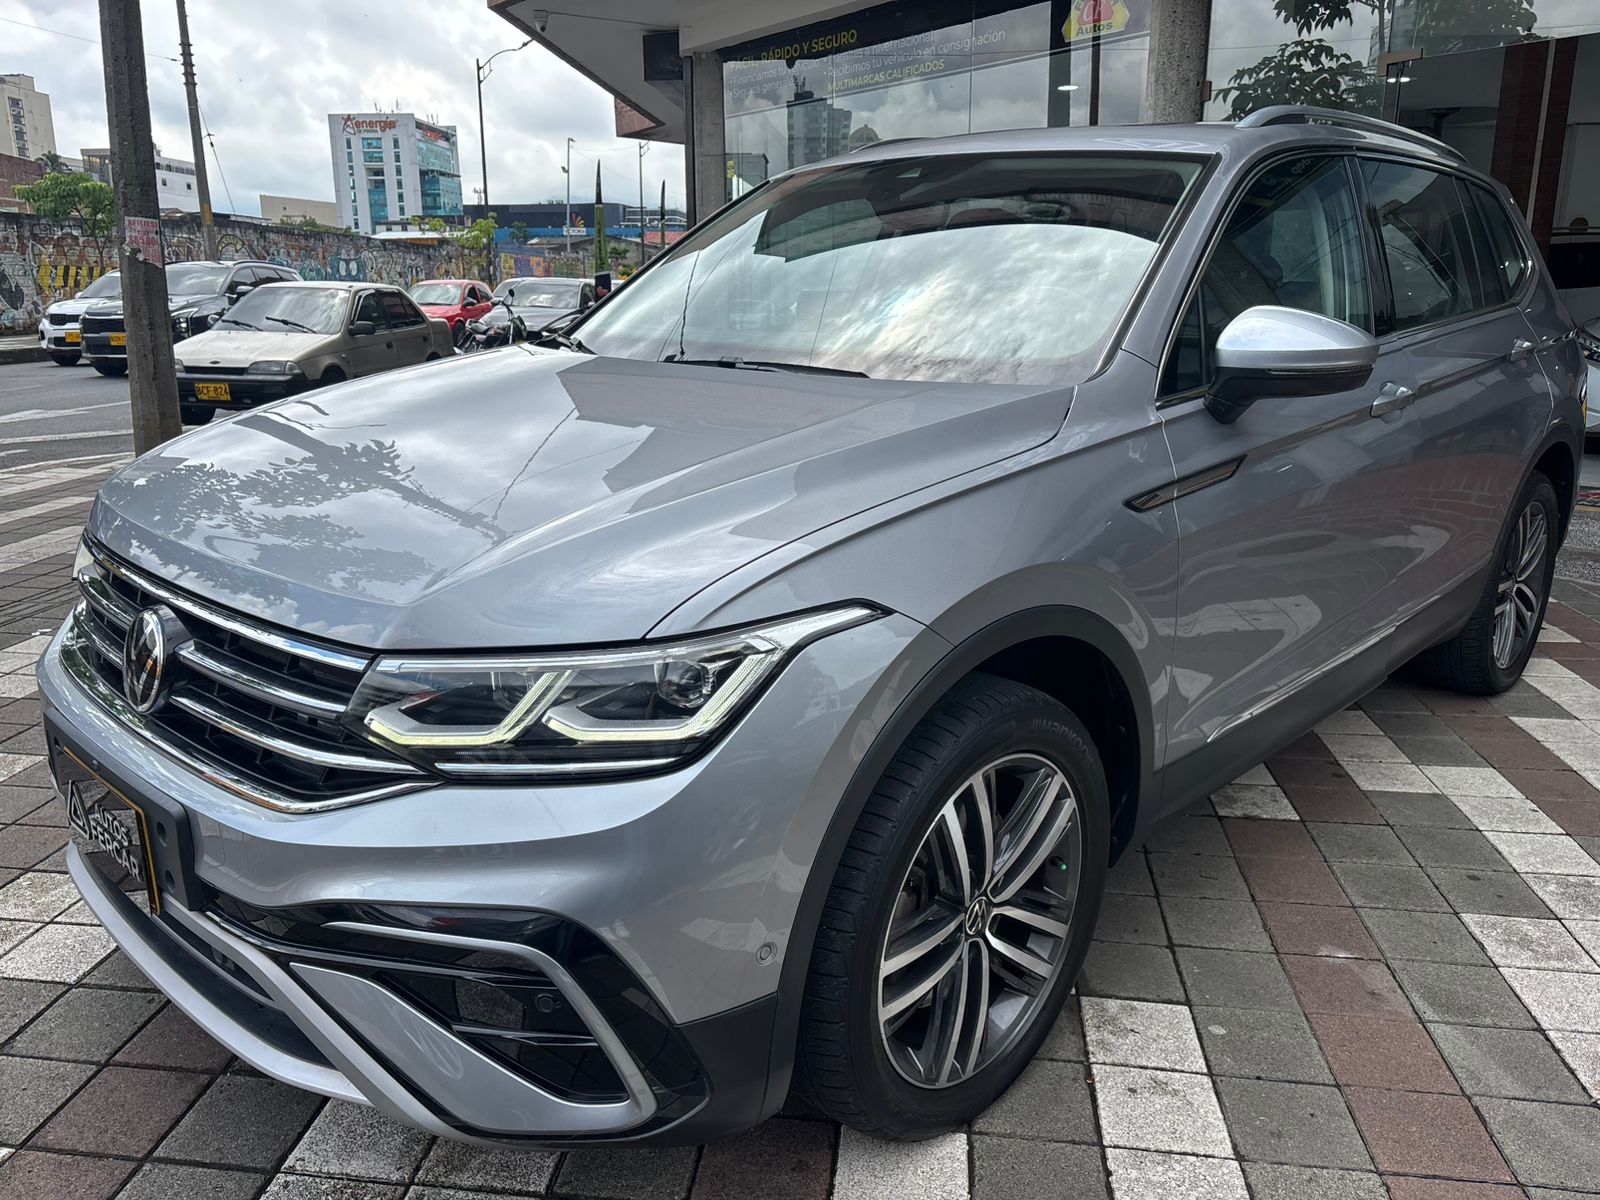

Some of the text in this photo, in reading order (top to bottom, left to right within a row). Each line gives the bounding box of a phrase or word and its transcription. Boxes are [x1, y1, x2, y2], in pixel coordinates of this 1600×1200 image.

[802, 41, 811, 55] Y
[811, 29, 858, 52] SEGURO
[1075, 22, 1114, 38] Autos
[923, 46, 936, 58] en
[827, 58, 945, 93] MULTIMARCAS CALIFICADOS
[94, 803, 130, 847] AUTOS
[90, 820, 141, 882] FERCAR
